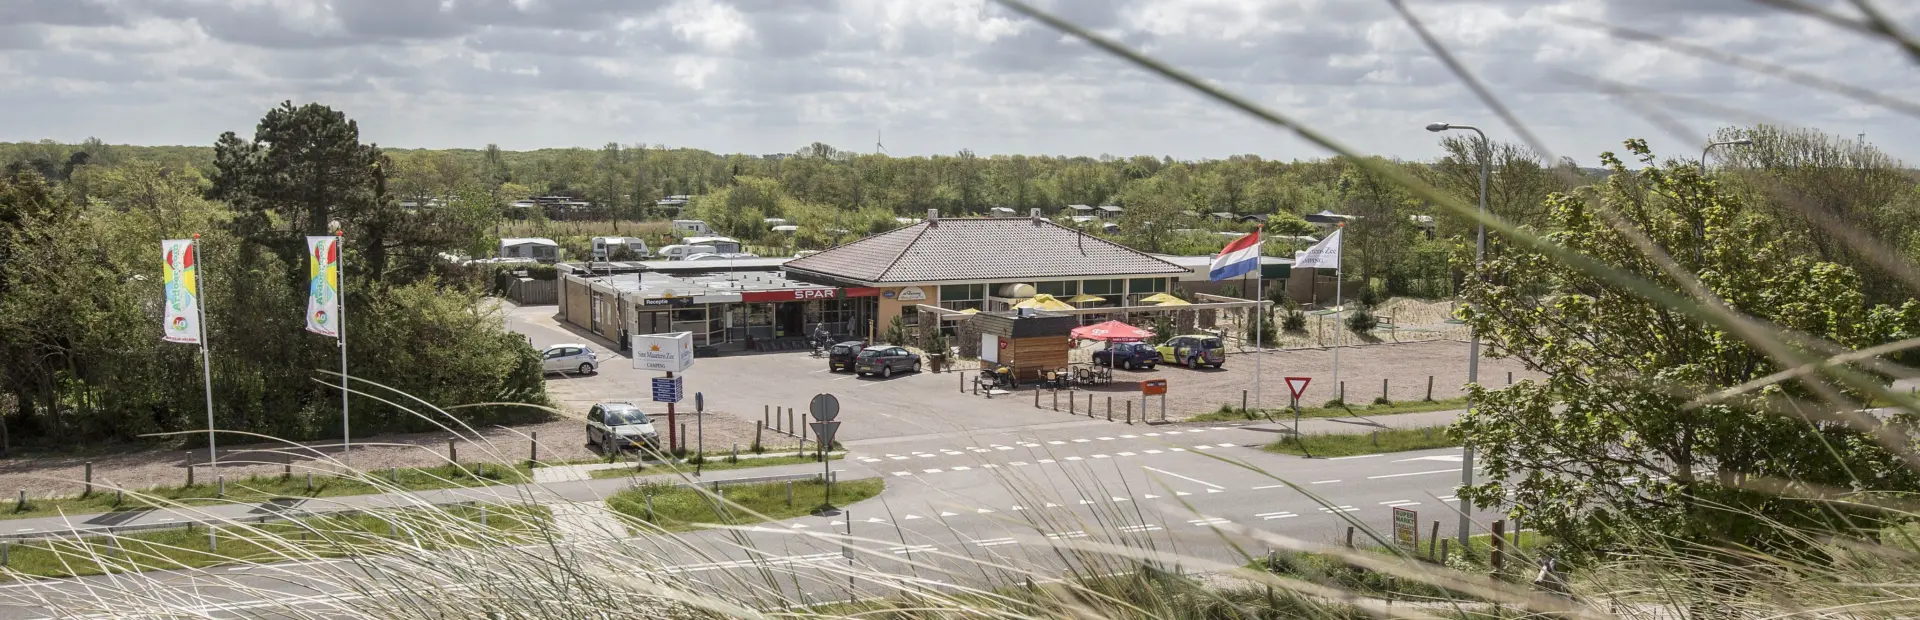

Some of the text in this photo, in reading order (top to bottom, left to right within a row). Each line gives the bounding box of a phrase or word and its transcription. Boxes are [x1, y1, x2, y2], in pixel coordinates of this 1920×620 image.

[172, 244, 181, 312] Ardoer.com
[315, 240, 324, 305] Ardoer.com
[794, 289, 834, 299] SPAR
[1395, 510, 1414, 519] SUPER
